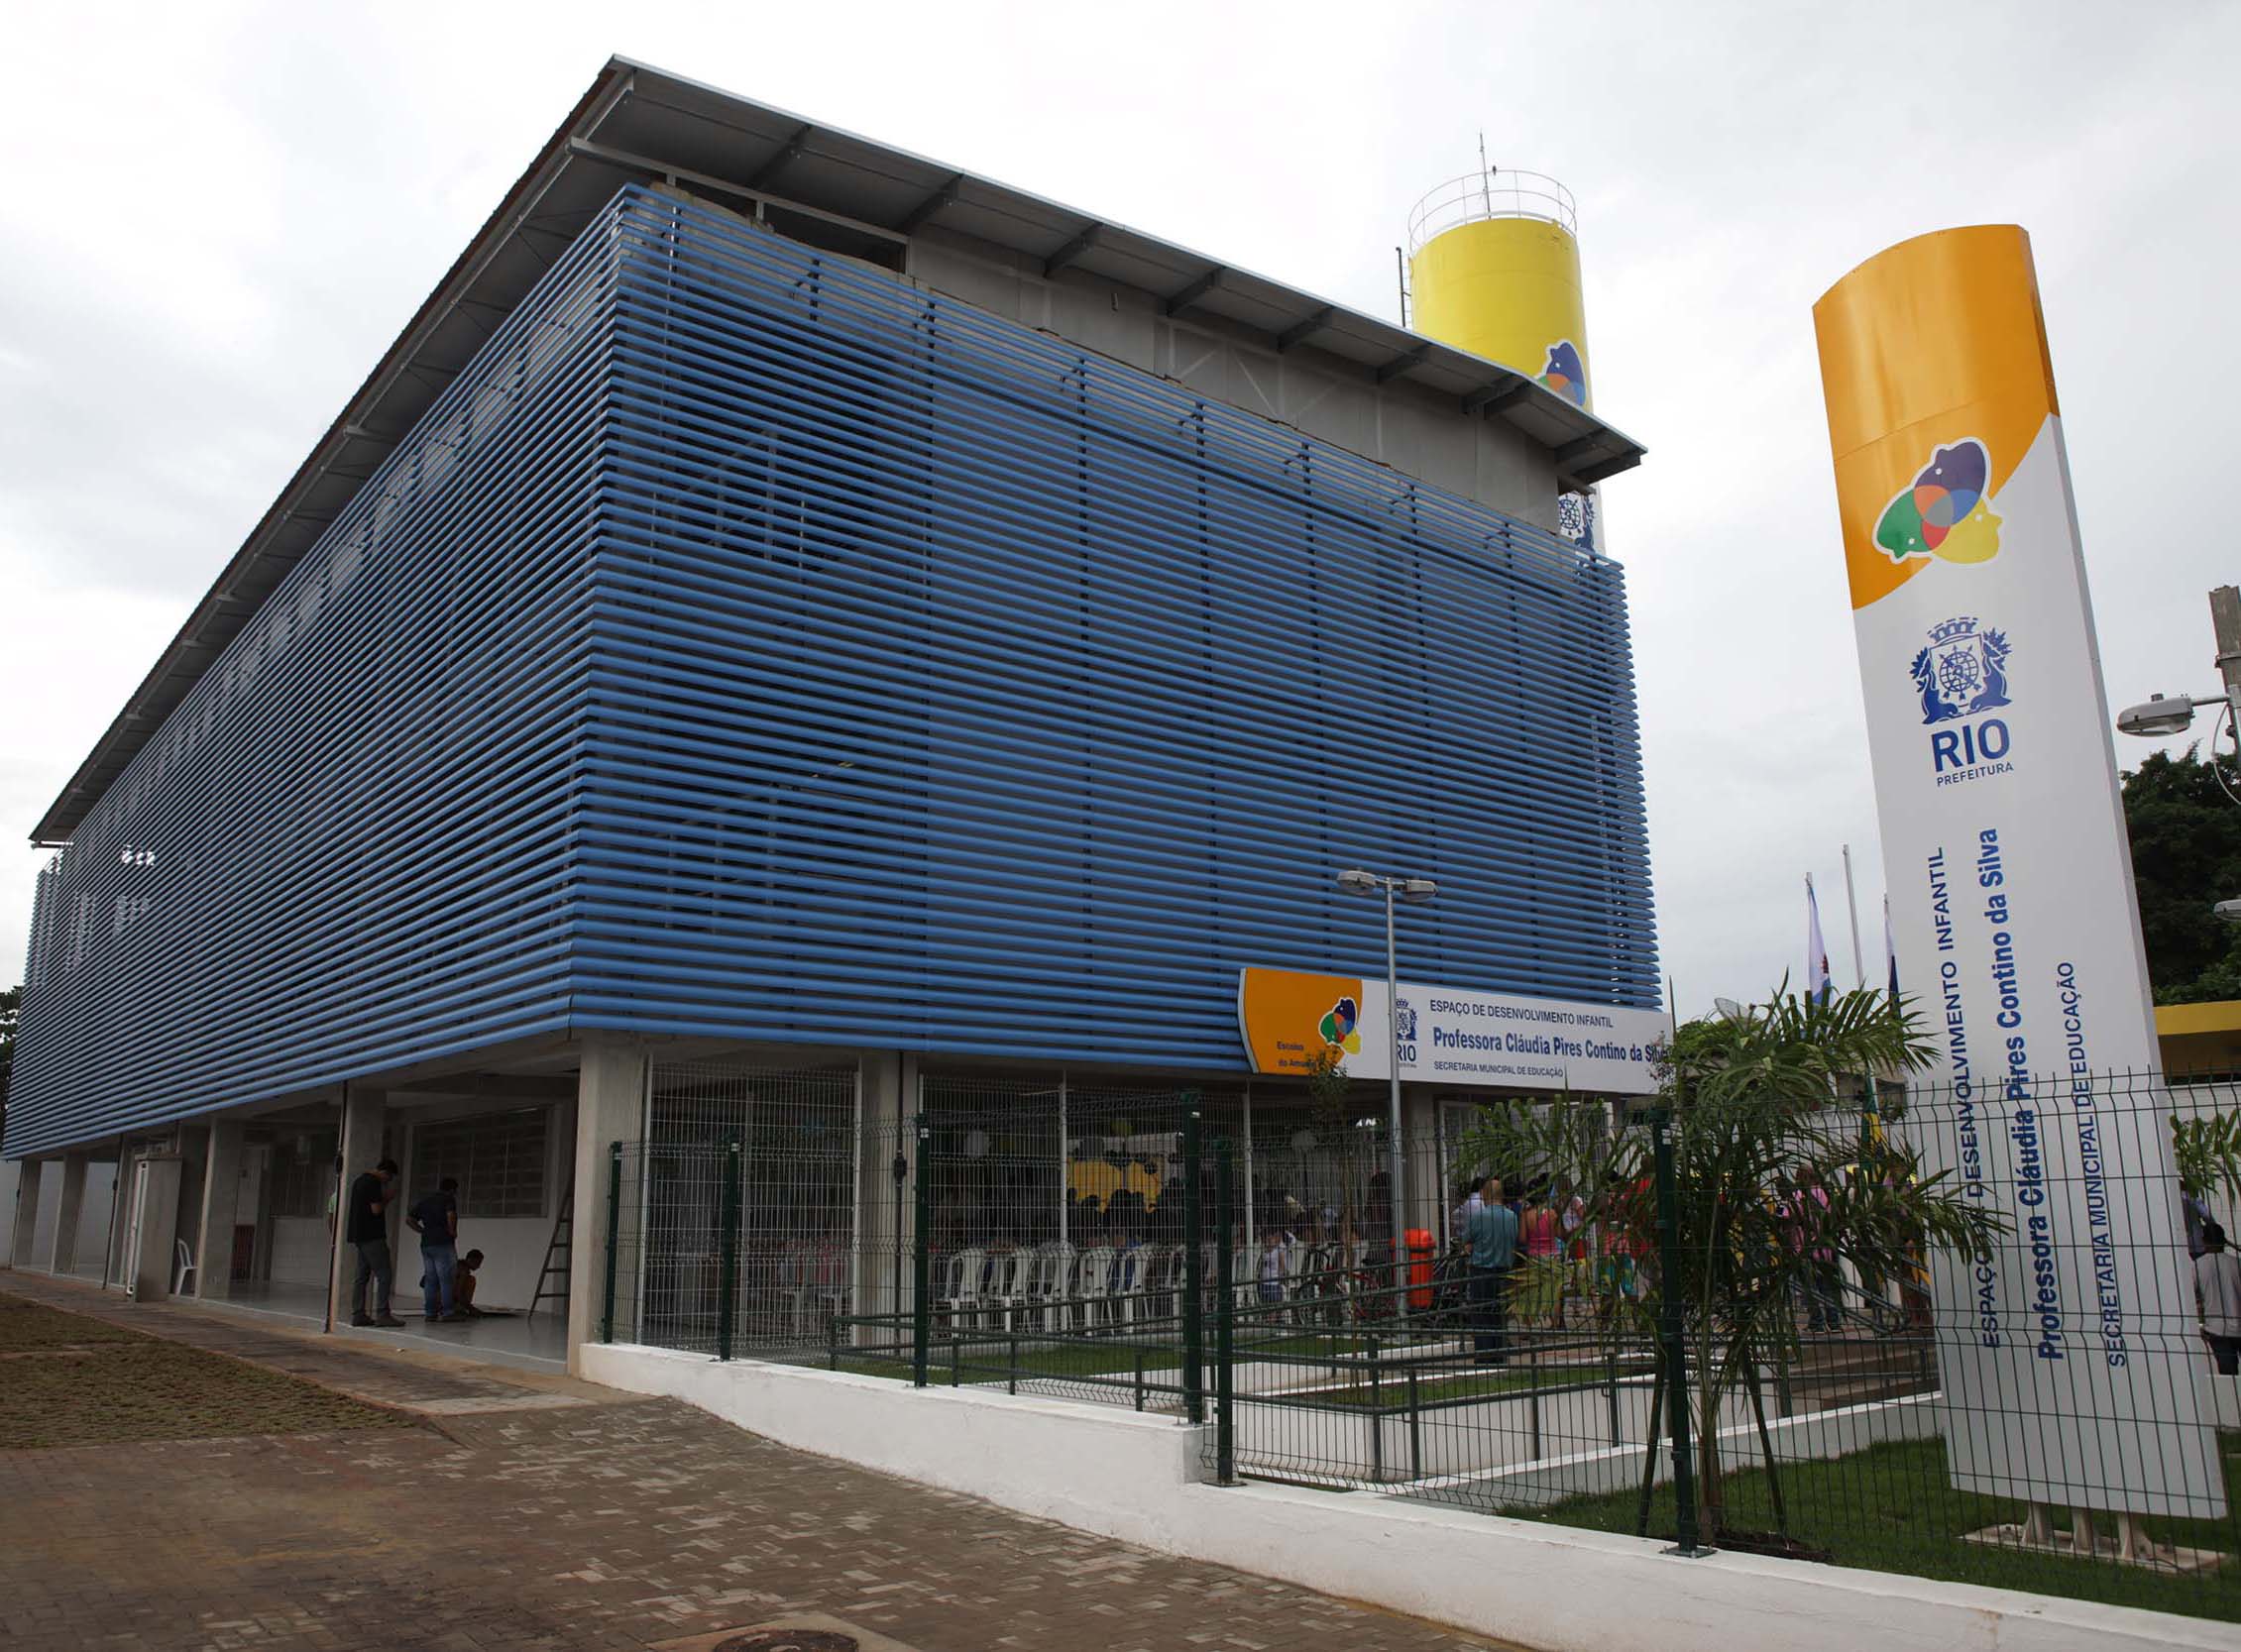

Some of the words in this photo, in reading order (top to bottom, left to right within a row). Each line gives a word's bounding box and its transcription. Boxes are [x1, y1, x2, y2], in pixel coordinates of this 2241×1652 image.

[1931, 718, 2010, 772] RIO
[1937, 761, 2014, 787] PREFEITURA
[1977, 828, 2003, 887] Silva
[1928, 847, 1954, 950] INFANTIL
[1984, 894, 2008, 924] da
[1991, 932, 2022, 1028] Contino
[1430, 999, 1470, 1016] ESPAÇO
[1473, 1004, 1486, 1016] DE
[1488, 1006, 1574, 1025] DESENVOLVIMENTO
[1577, 1014, 1614, 1028] INFANTIL
[2057, 962, 2086, 1073] EDUCAÇÃO
[1395, 1045, 1416, 1061] RIO
[1433, 1027, 1502, 1050] Professora
[1506, 1033, 1550, 1055] Cláudia
[1553, 1037, 1582, 1056] Pires
[1586, 1041, 1626, 1060] Contino
[1629, 1044, 1642, 1062] da
[1434, 1060, 1478, 1072] SECRETARIA
[1479, 1063, 1515, 1075] MUNICIPAL
[1517, 1065, 1526, 1075] DE
[1528, 1065, 1563, 1078] EDUCAÇÃO
[2005, 1037, 2031, 1100] Pires
[1941, 961, 1983, 1197] DESENVOLVIMENTO
[2073, 1079, 2091, 1107] DE
[2012, 1110, 2044, 1206] Cláudia
[2078, 1115, 2107, 1226] MUNICIPAL
[2029, 1216, 2064, 1360] Professora
[2093, 1233, 2126, 1367] SECRETARIA
